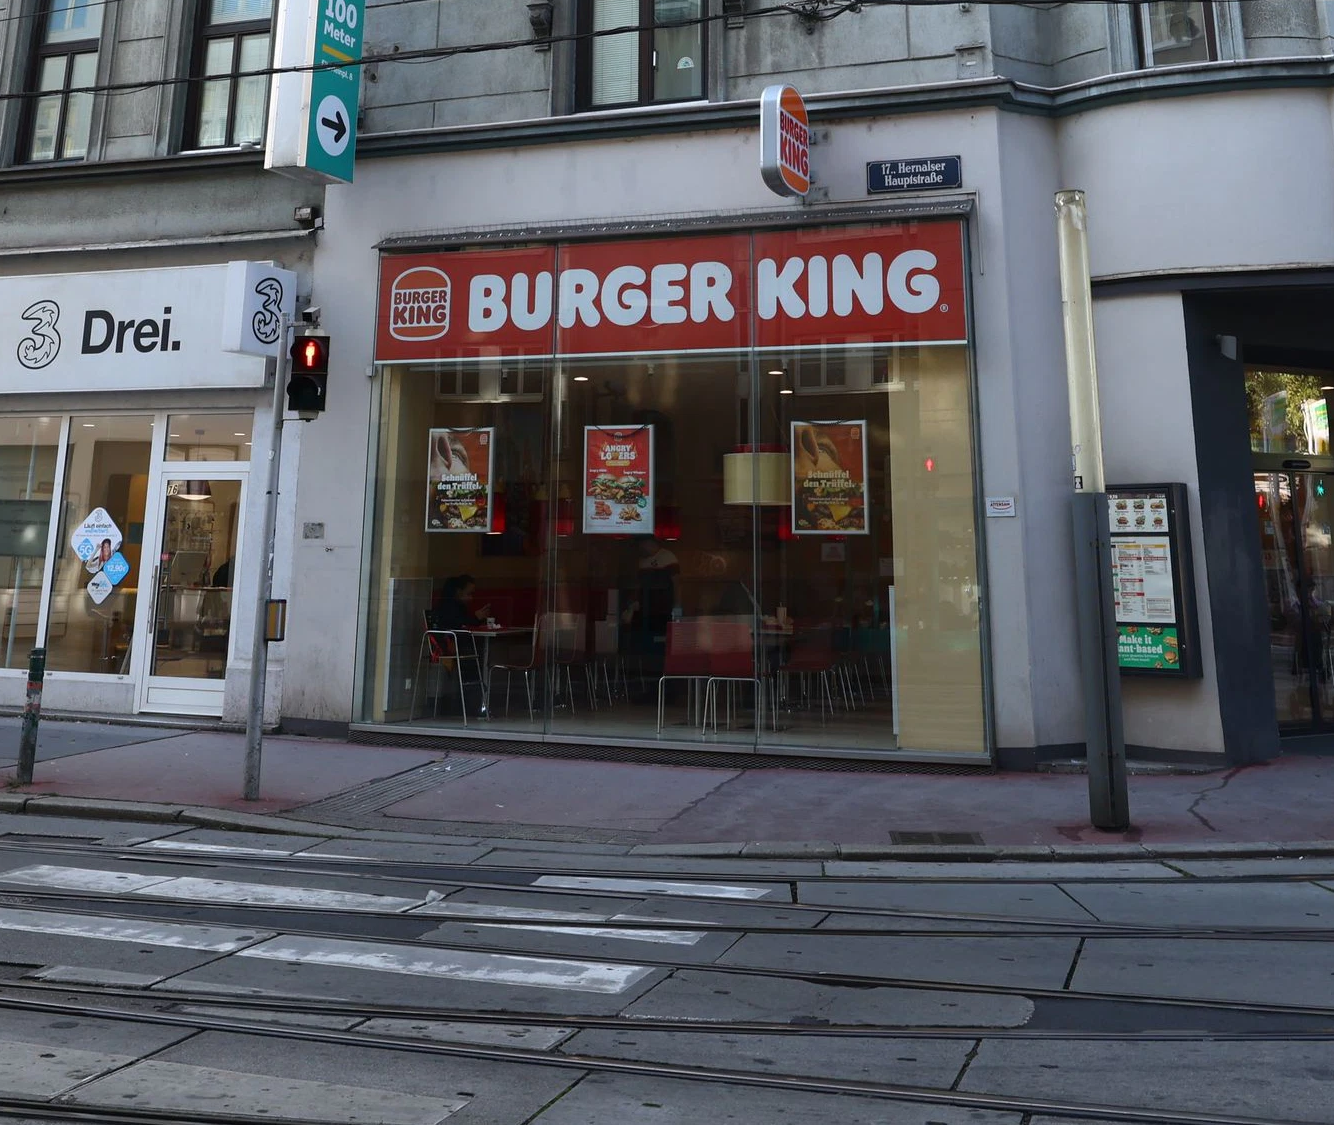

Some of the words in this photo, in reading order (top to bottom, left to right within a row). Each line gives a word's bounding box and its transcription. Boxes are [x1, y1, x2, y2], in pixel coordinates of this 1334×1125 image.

[323, 19, 356, 49] Meter
[780, 109, 809, 150] BURGER
[780, 132, 809, 178] KING
[898, 160, 946, 174] Hernalser
[884, 171, 944, 188] Hauptstraße
[393, 289, 448, 306] BURGER
[467, 262, 736, 333] BURGER
[757, 248, 941, 319] KING
[252, 277, 284, 345] 3
[392, 304, 447, 326] KING
[16, 299, 62, 370] 3
[80, 306, 181, 355] Drei.
[600, 451, 636, 460] LOERS
[604, 444, 632, 452] ANGRY
[441, 473, 478, 482] Schnüffel
[803, 479, 819, 488] den
[437, 482, 452, 490] den
[79, 544, 93, 556] 5G
[1119, 634, 1143, 645] Make
[1144, 634, 1153, 645] it
[1118, 643, 1163, 654] ant-based
